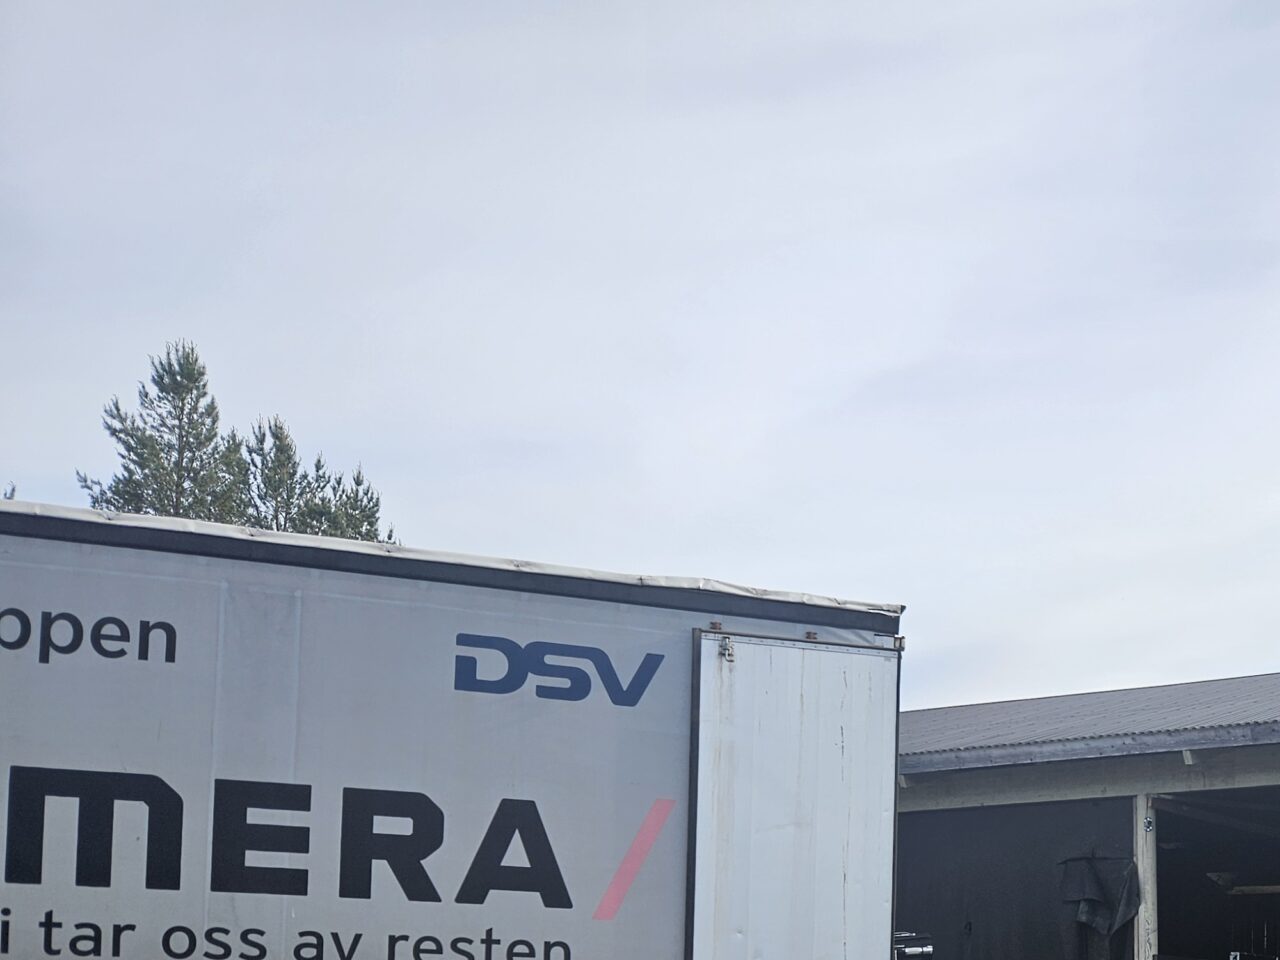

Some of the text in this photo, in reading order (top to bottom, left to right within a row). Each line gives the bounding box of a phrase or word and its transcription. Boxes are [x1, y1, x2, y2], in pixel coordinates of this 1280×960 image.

[454, 633, 665, 707] DSV
[4, 765, 573, 909] MERA
[39, 909, 136, 957] tar
